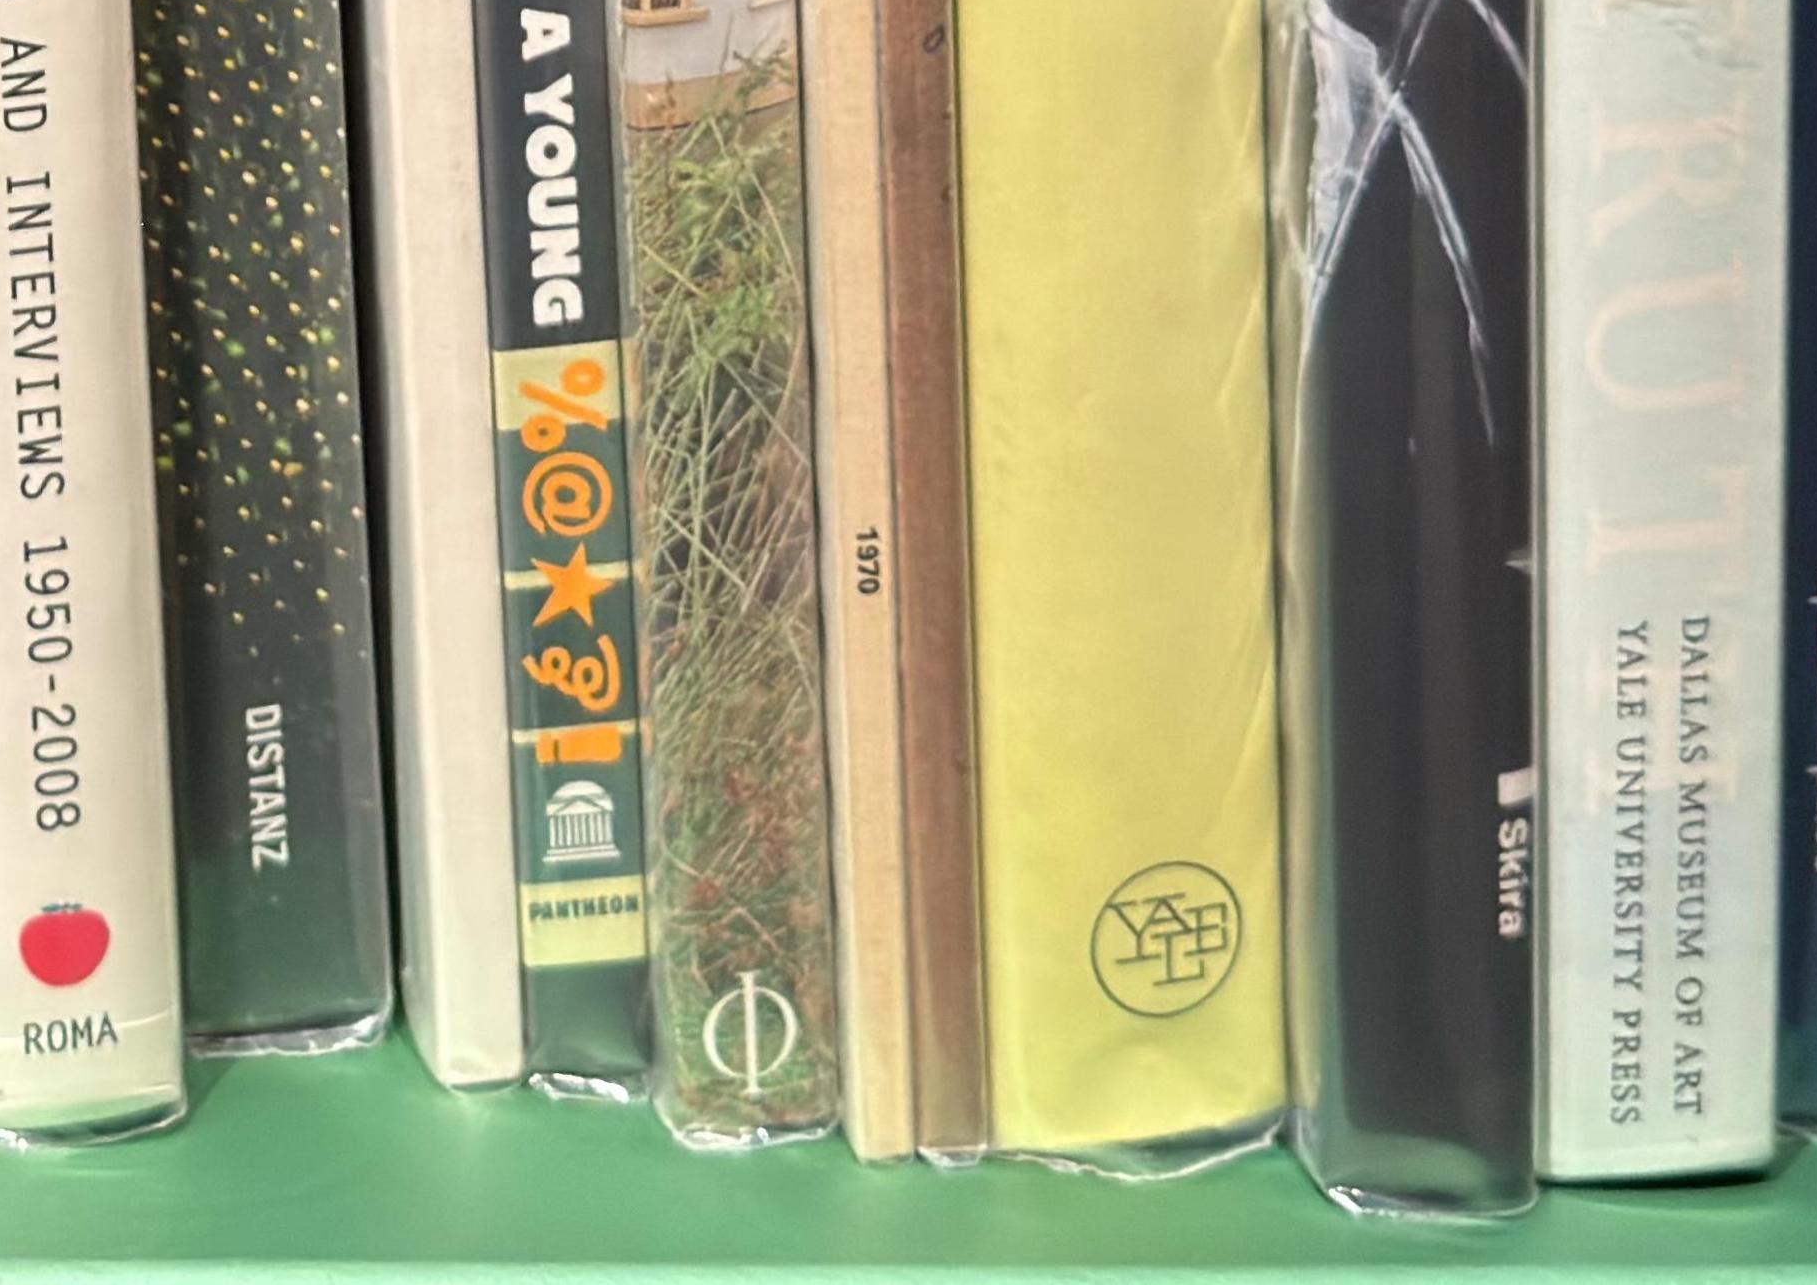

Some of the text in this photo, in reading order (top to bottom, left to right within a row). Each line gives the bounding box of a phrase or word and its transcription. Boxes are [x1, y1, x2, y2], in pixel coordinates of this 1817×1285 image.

[0, 37, 47, 132] AND
[522, 8, 570, 60] A
[525, 75, 582, 323] YOUNG
[5, 173, 67, 502] INTERVIEWS
[855, 527, 881, 595] 1970
[19, 538, 82, 832] 1950-2008
[244, 705, 289, 867] DISTANZ
[529, 895, 639, 922] PANTHEON
[1498, 818, 1530, 937] Skira
[1610, 620, 1650, 1125] YALE UNIVERSITY PRESS
[1672, 616, 1711, 1115] DALLAS MUSEUM ART
[24, 1010, 119, 1052] ROMA
